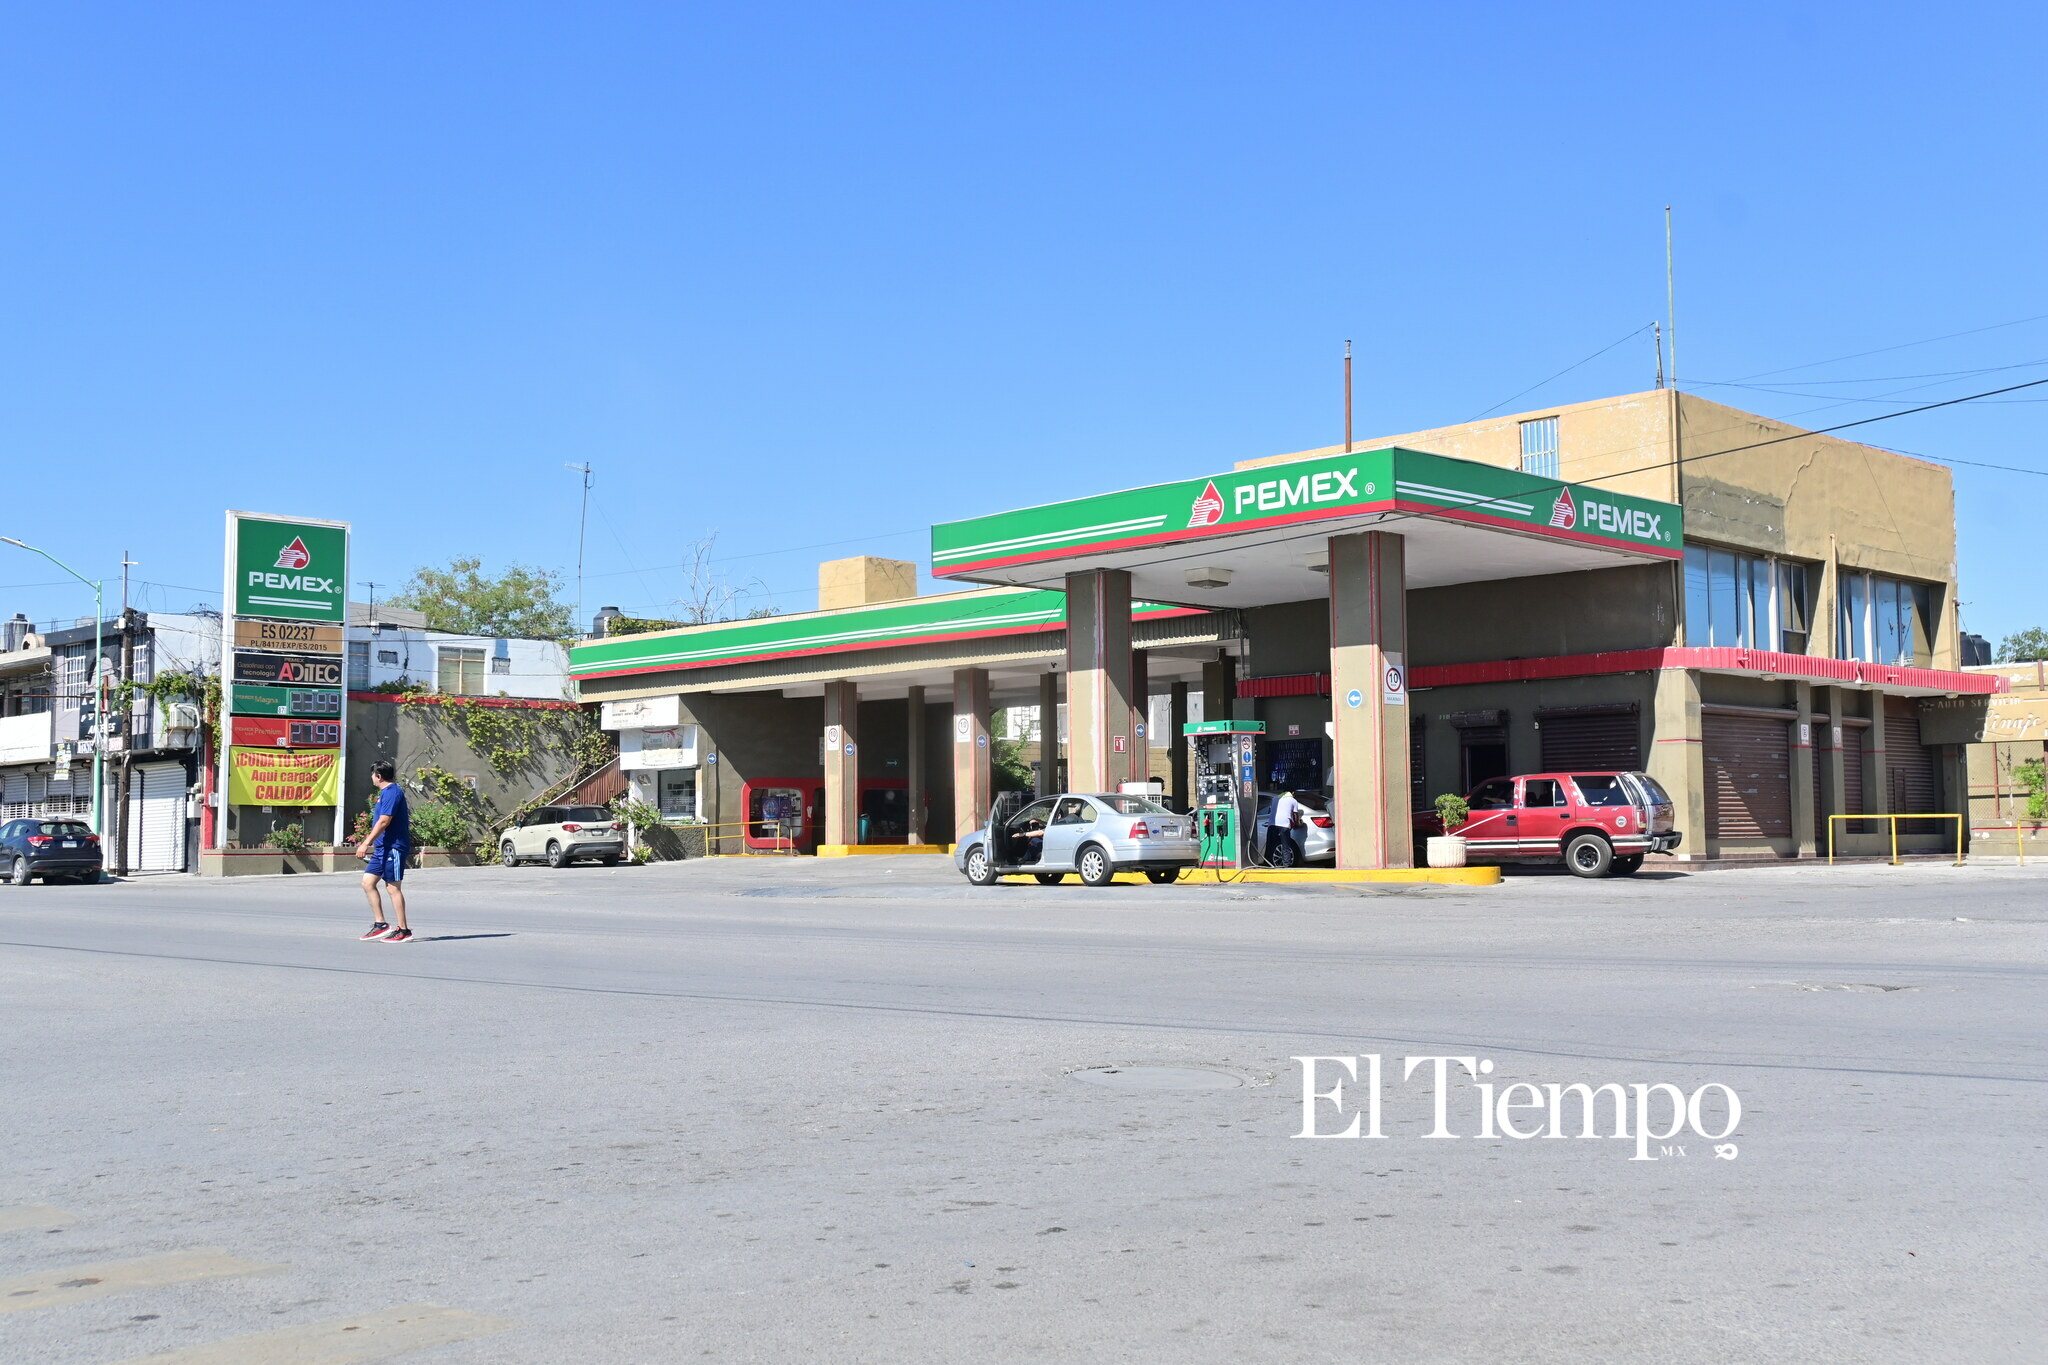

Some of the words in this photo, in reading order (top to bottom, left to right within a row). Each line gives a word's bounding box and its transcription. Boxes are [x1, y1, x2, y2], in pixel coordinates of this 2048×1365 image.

[1235, 467, 1358, 515] PEMEX
[1583, 500, 1661, 540] PEMEX
[248, 571, 333, 593] PEMEX
[261, 624, 276, 639] ES
[279, 626, 315, 641] 02237
[250, 639, 328, 651] PL/8417/EXP/ES/2015
[1388, 672, 1399, 684] 10
[1937, 699, 1965, 709] AUTO
[1258, 722, 1264, 732] 2
[276, 753, 291, 768] TU
[280, 771, 319, 784] cargas
[255, 785, 313, 800] CALIDAD
